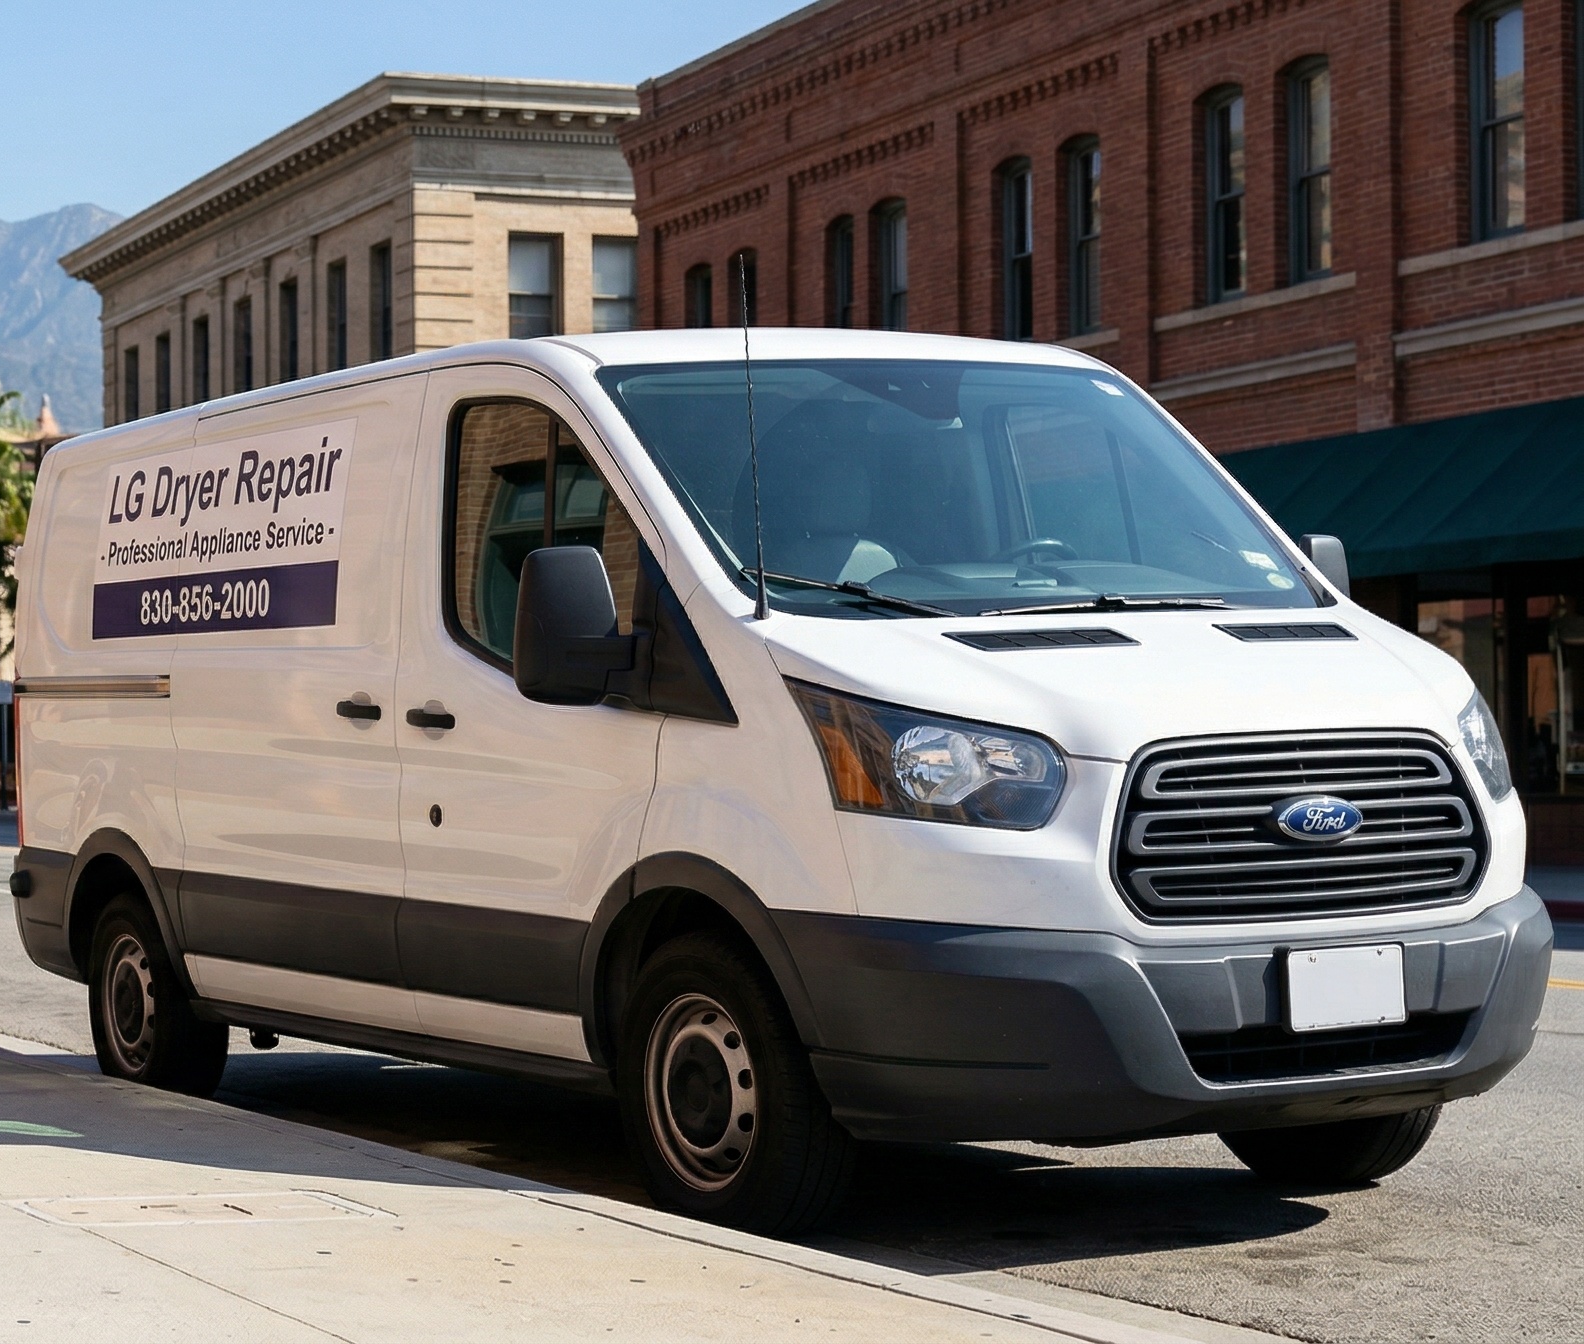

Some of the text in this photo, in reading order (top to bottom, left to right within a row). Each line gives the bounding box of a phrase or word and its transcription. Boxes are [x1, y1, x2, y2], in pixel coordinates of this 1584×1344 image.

[108, 436, 343, 527] LG Dryer Repair
[108, 517, 324, 567] Professional Appliance Service
[140, 578, 270, 626] 830-856-2000
